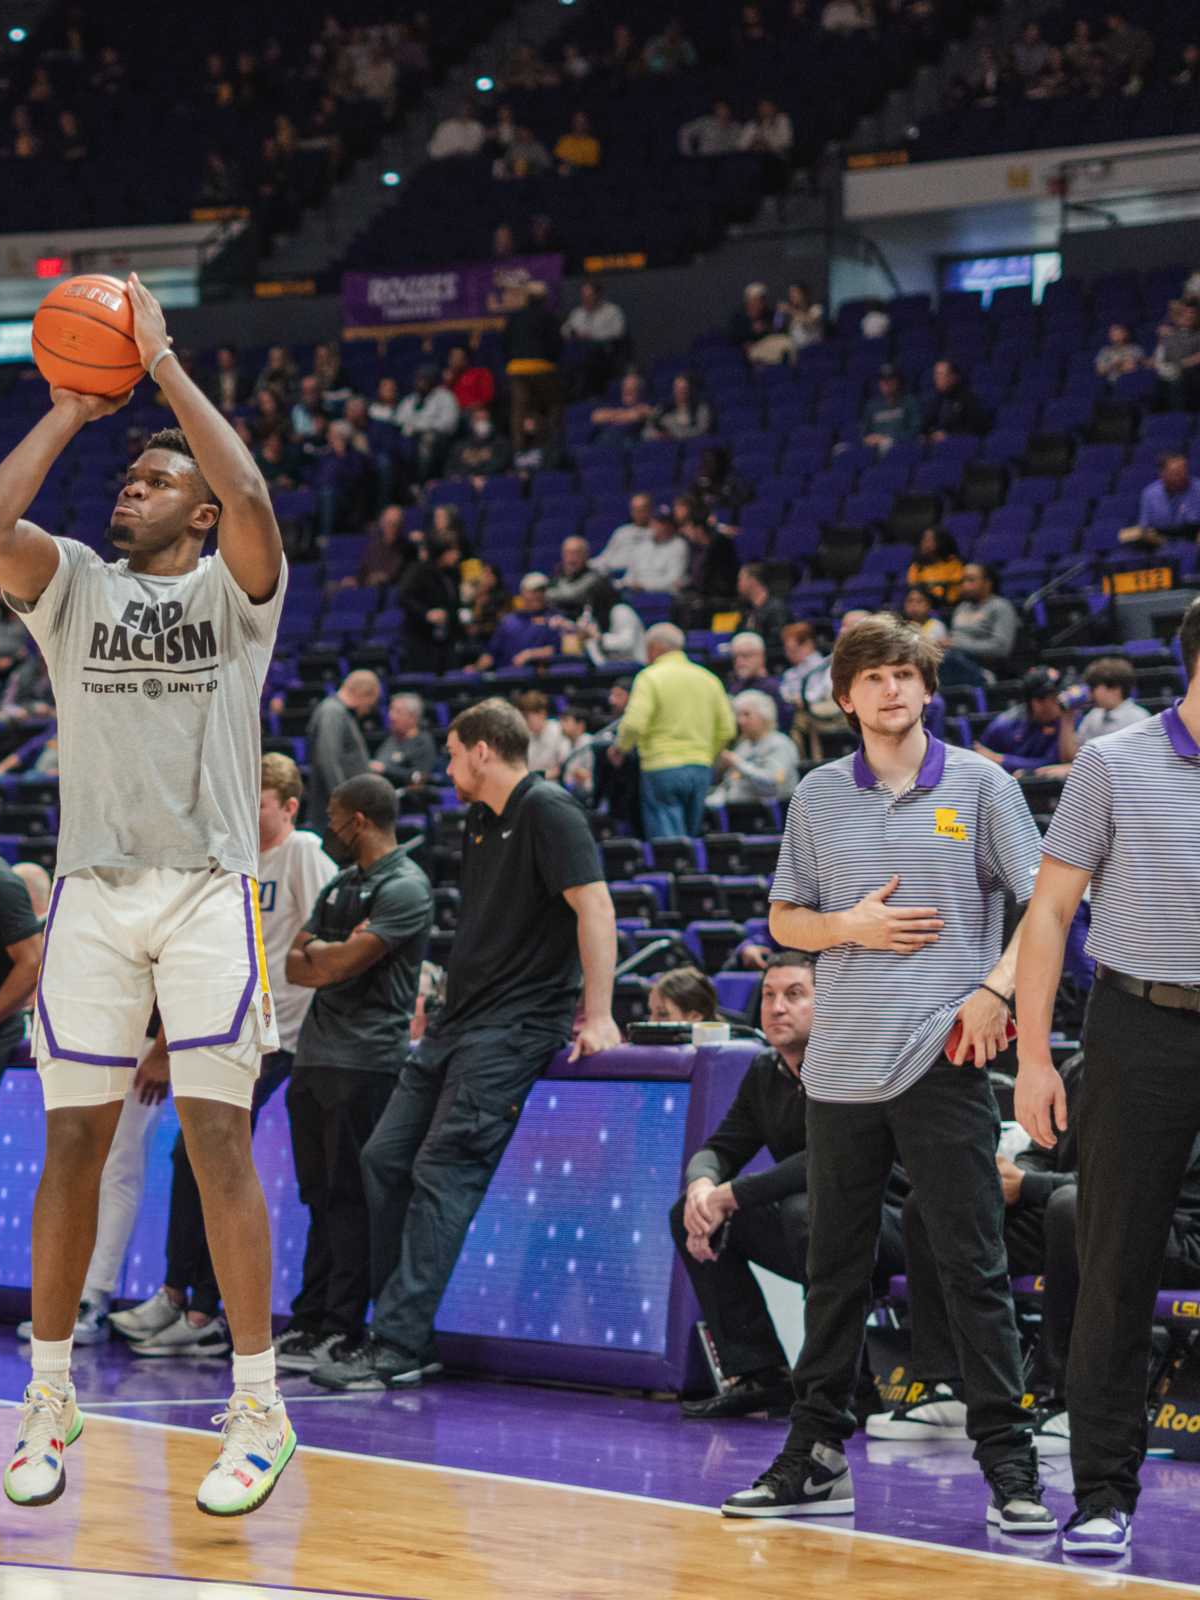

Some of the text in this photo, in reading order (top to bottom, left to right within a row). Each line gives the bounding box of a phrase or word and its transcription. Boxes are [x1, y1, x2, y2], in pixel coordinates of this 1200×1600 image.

[121, 600, 183, 635] END
[89, 620, 217, 664] RACISM
[81, 682, 138, 694] TIGERS
